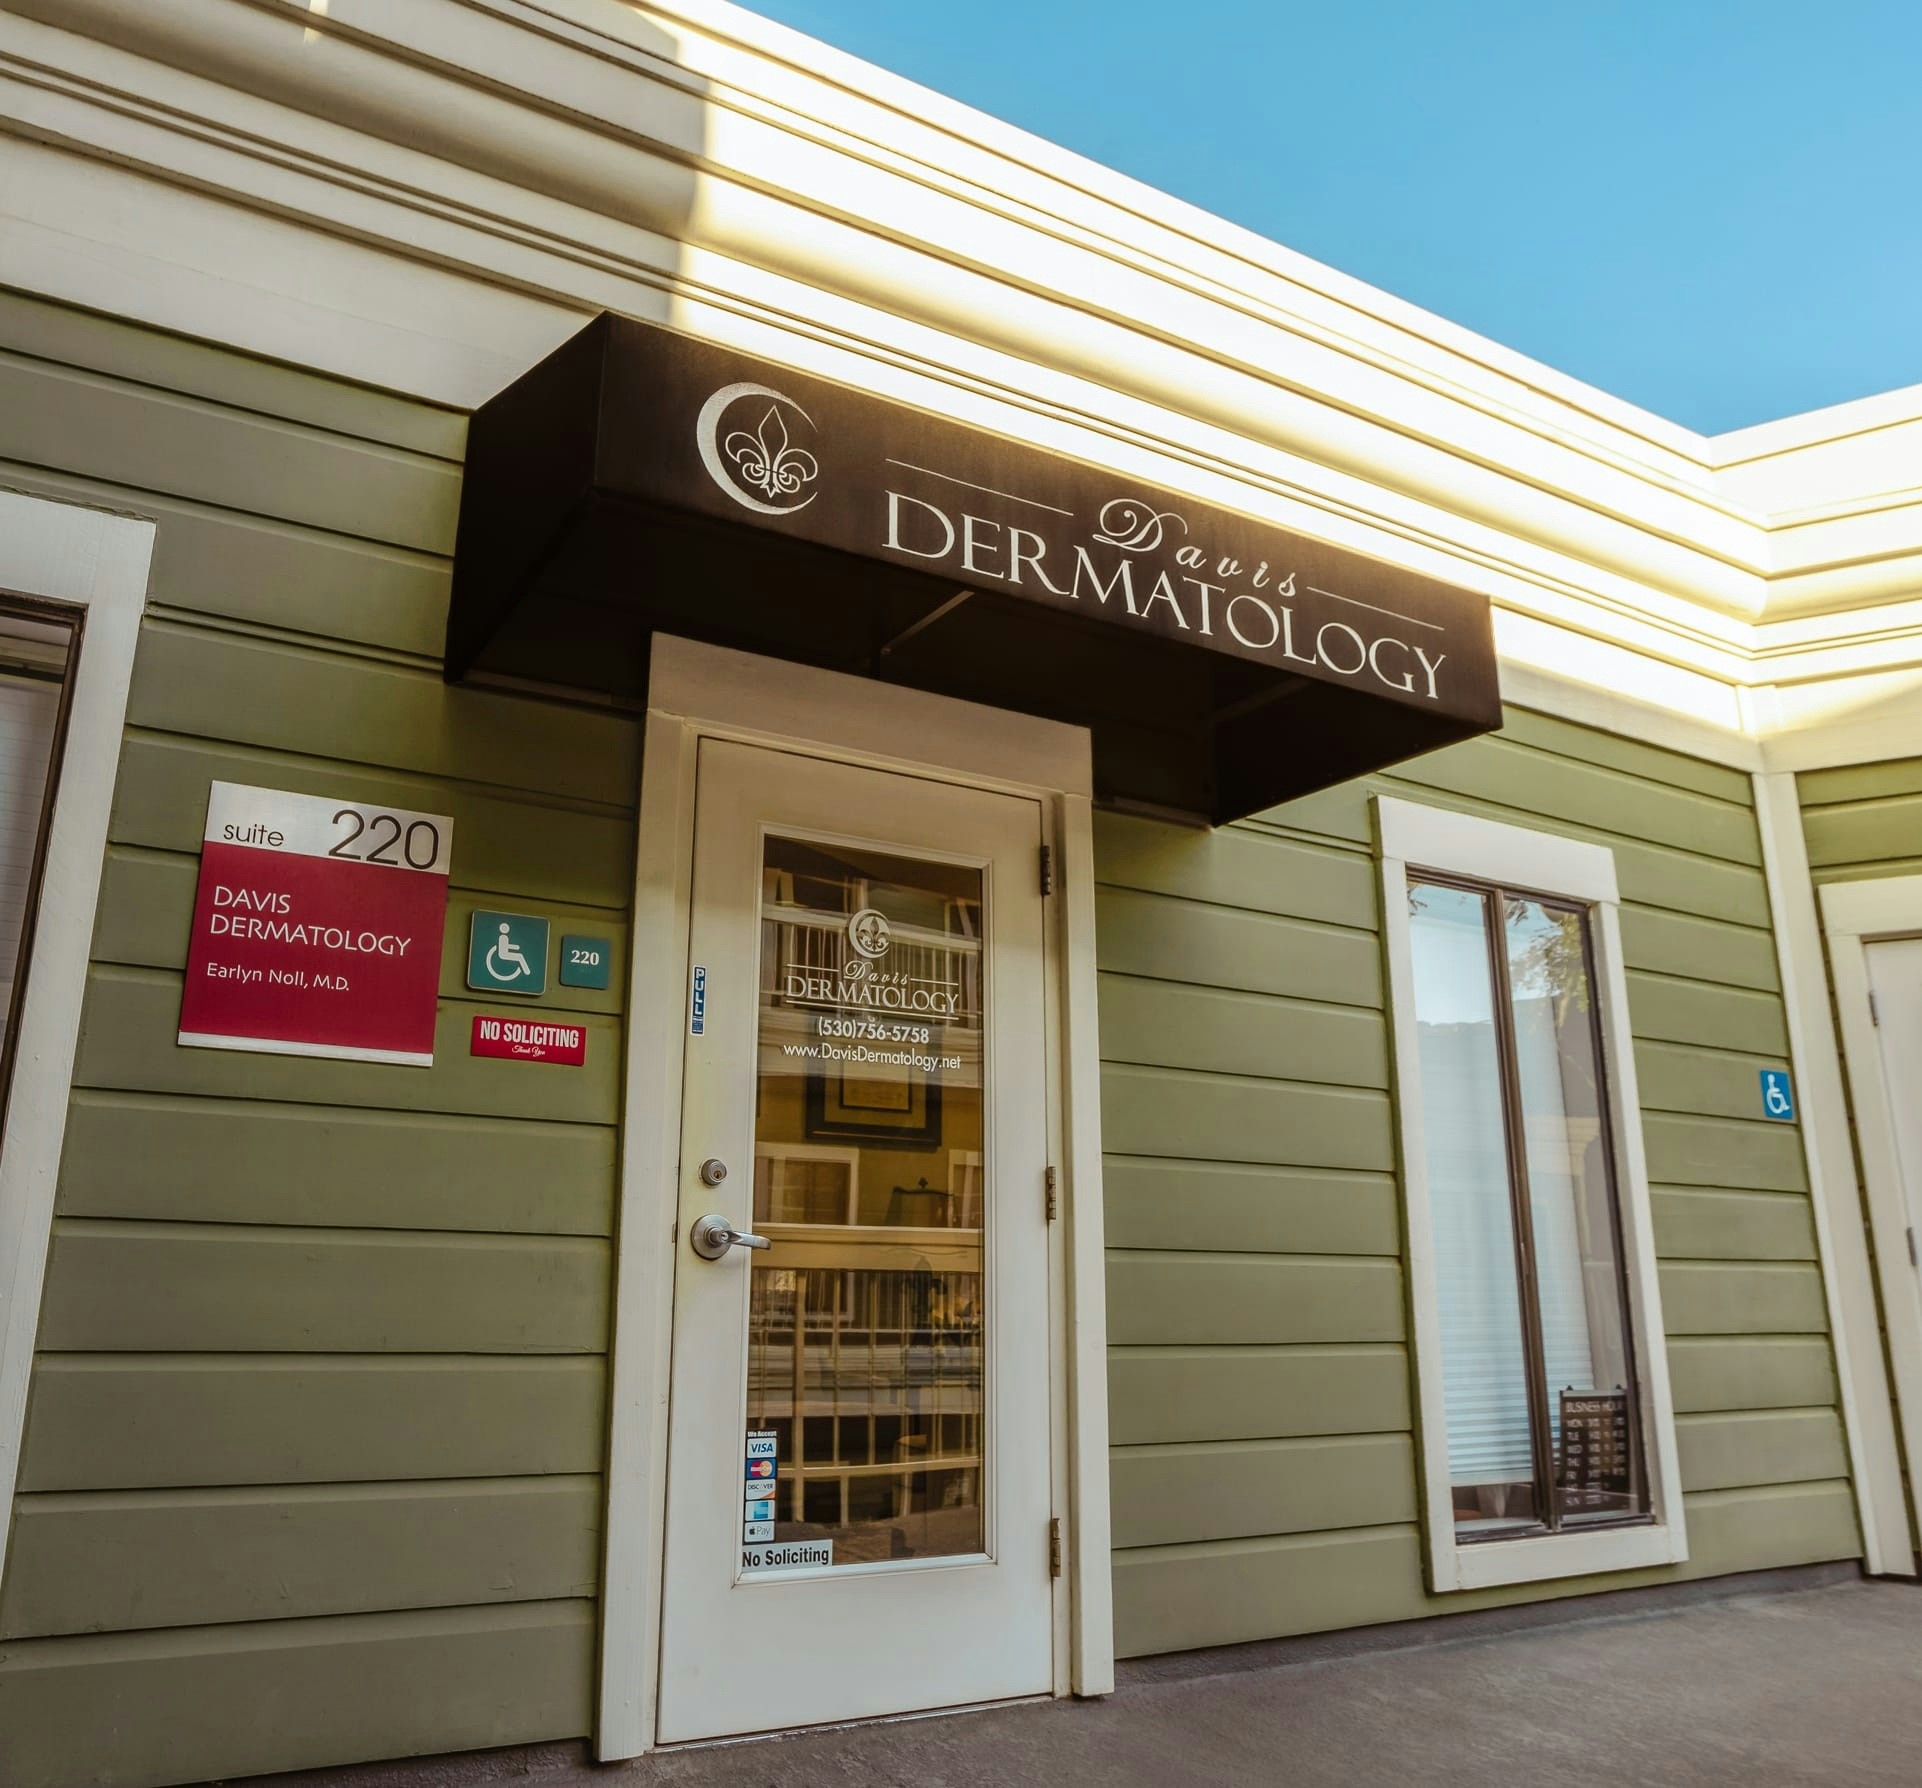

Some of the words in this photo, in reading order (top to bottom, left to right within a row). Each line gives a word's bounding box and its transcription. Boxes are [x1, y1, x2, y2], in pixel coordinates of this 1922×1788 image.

[1093, 497, 1298, 597] Davis
[881, 489, 1447, 699] DERMATOLOGY
[223, 822, 284, 848] suite
[328, 809, 439, 870] 220
[213, 885, 291, 914] DAVIS
[210, 914, 411, 957] DERMATOLOGY
[570, 949, 600, 966] 220
[206, 962, 263, 986] Earlyn
[268, 968, 308, 990] Noll,
[313, 974, 350, 991] M.D.
[843, 960, 909, 985] Davis
[694, 968, 705, 1015] PULL
[786, 975, 959, 1014] DERMATOLOGY
[480, 1020, 501, 1041] NO
[503, 1023, 579, 1049] SOLICITING
[818, 1016, 930, 1044] (530)756-5758
[783, 1042, 961, 1072] www.DavisDermatology.net
[751, 1443, 774, 1453] VISA
[756, 1526, 771, 1537] Pay
[742, 1551, 761, 1568] No
[765, 1547, 830, 1566] Soliciting
